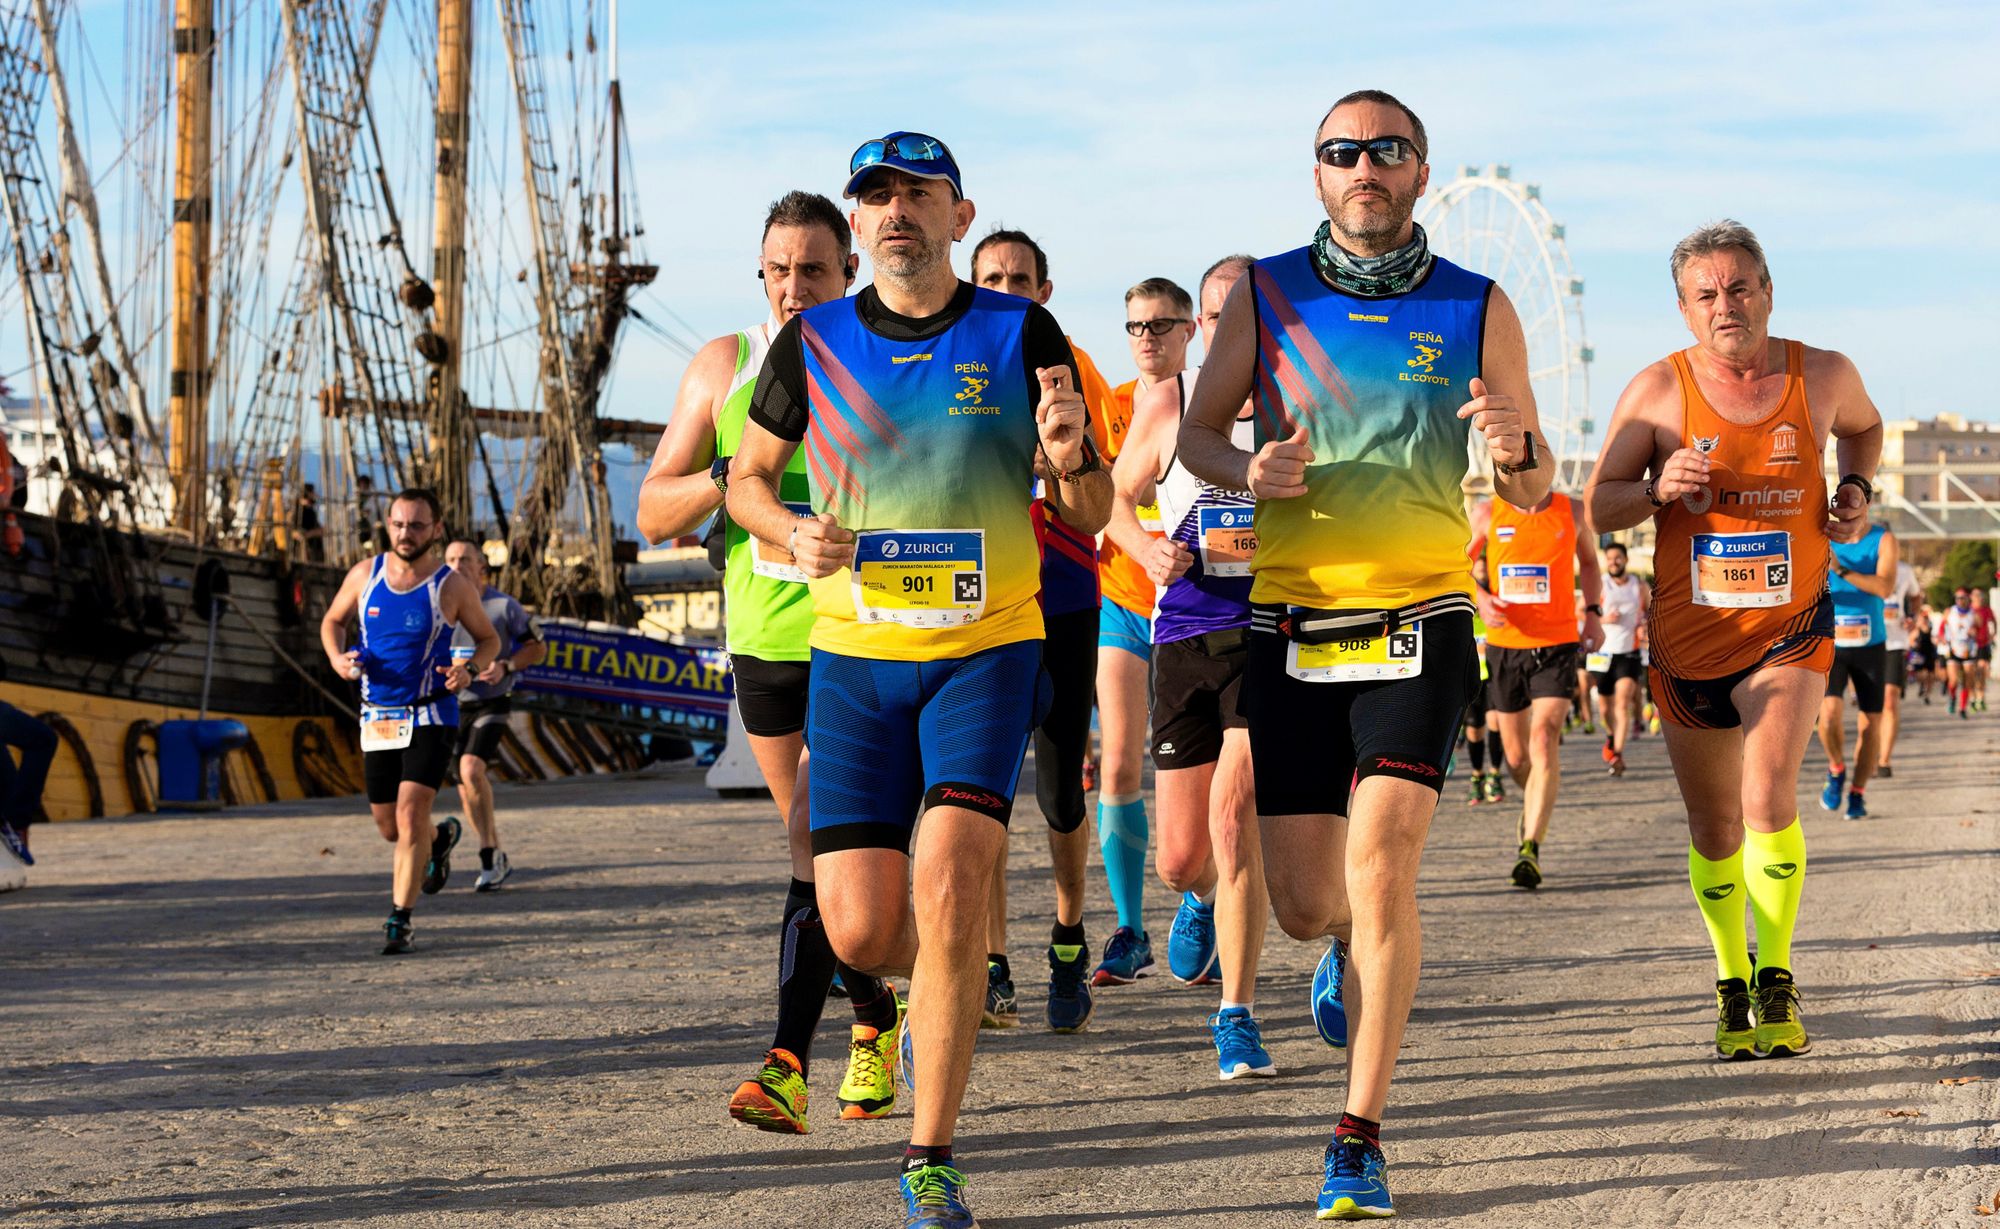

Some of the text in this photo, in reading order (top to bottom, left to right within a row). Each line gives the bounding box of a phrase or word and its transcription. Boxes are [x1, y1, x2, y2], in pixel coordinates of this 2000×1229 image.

[1409, 331, 1444, 344] PEÑA
[954, 360, 989, 374] PEÑA
[1398, 372, 1450, 386] EL COYOTE
[948, 406, 1001, 416] EL COYOTE
[904, 543, 953, 554] ZURICH
[1726, 543, 1766, 553] ZURICH
[1723, 568, 1755, 581] 1861
[902, 576, 933, 592] 901
[1339, 638, 1370, 653] 908
[531, 640, 730, 692] HTANDAR
